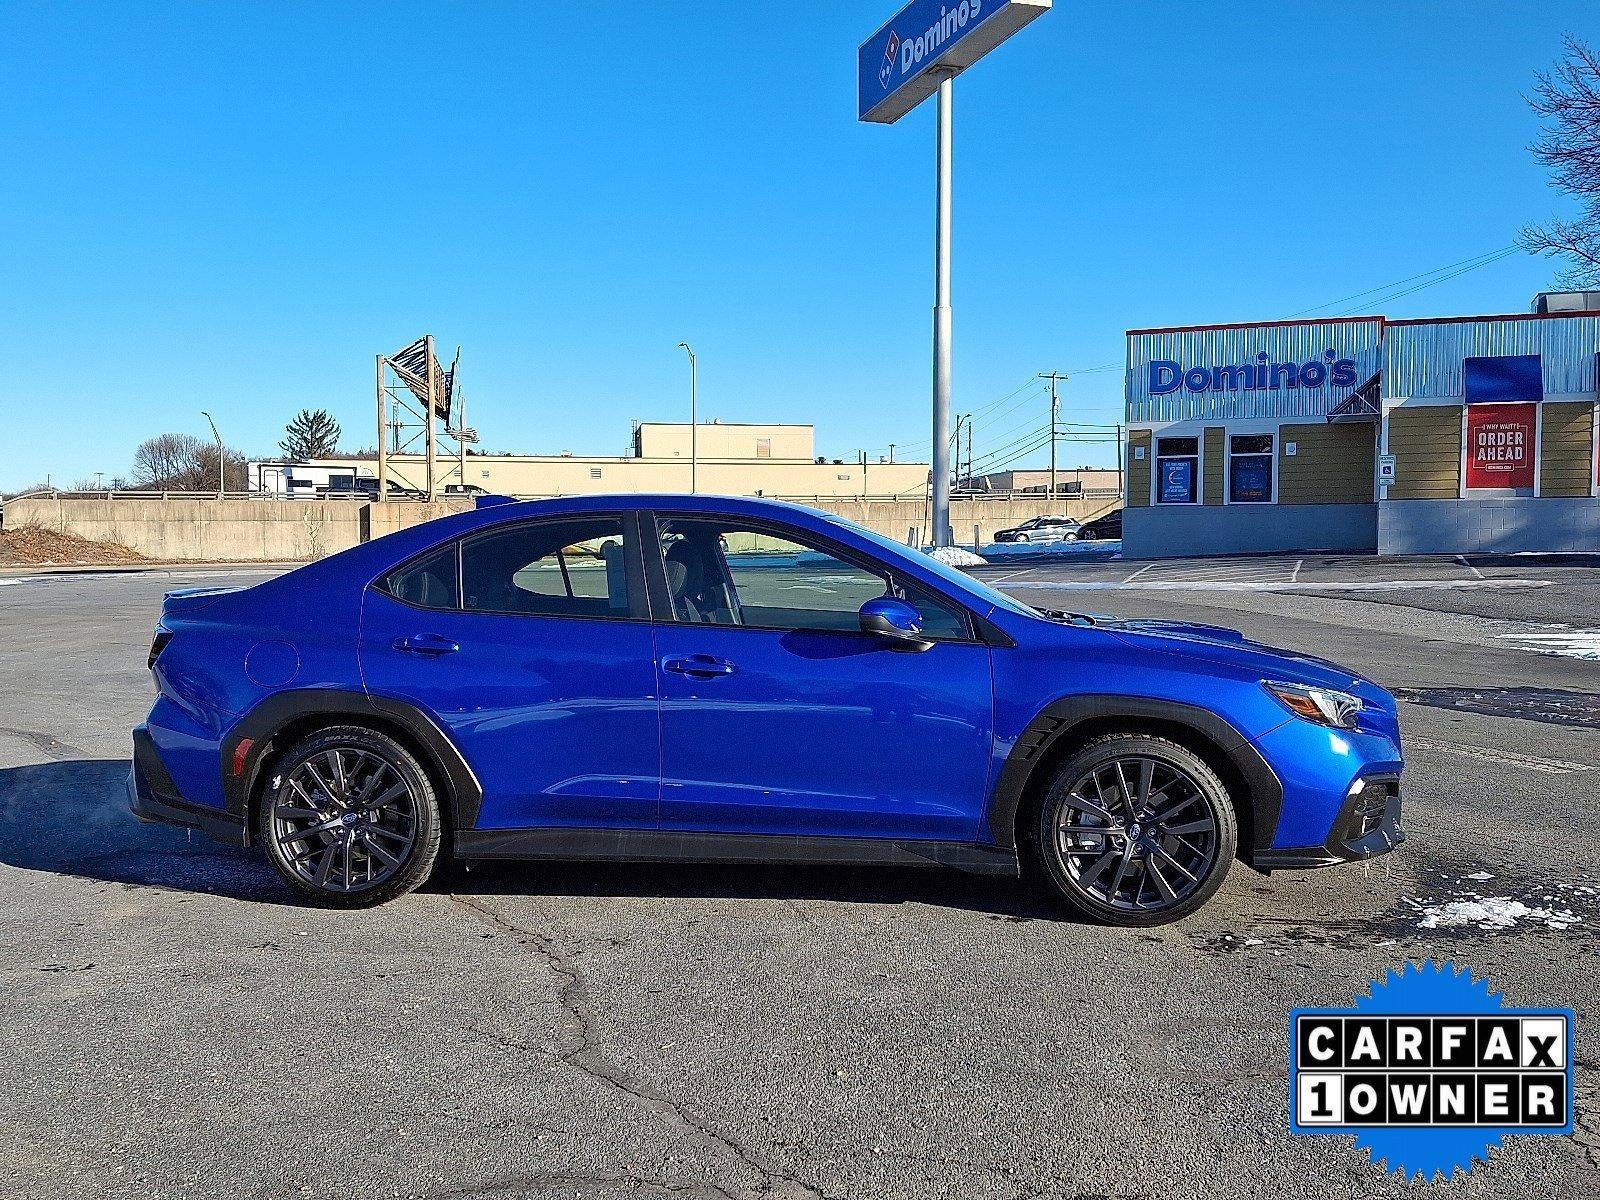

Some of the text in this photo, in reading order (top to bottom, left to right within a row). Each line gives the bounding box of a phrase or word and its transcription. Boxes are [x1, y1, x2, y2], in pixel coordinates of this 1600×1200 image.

[1149, 347, 1358, 394] Domino's
[1478, 431, 1524, 446] ORDER
[1477, 446, 1523, 461] AHEAD
